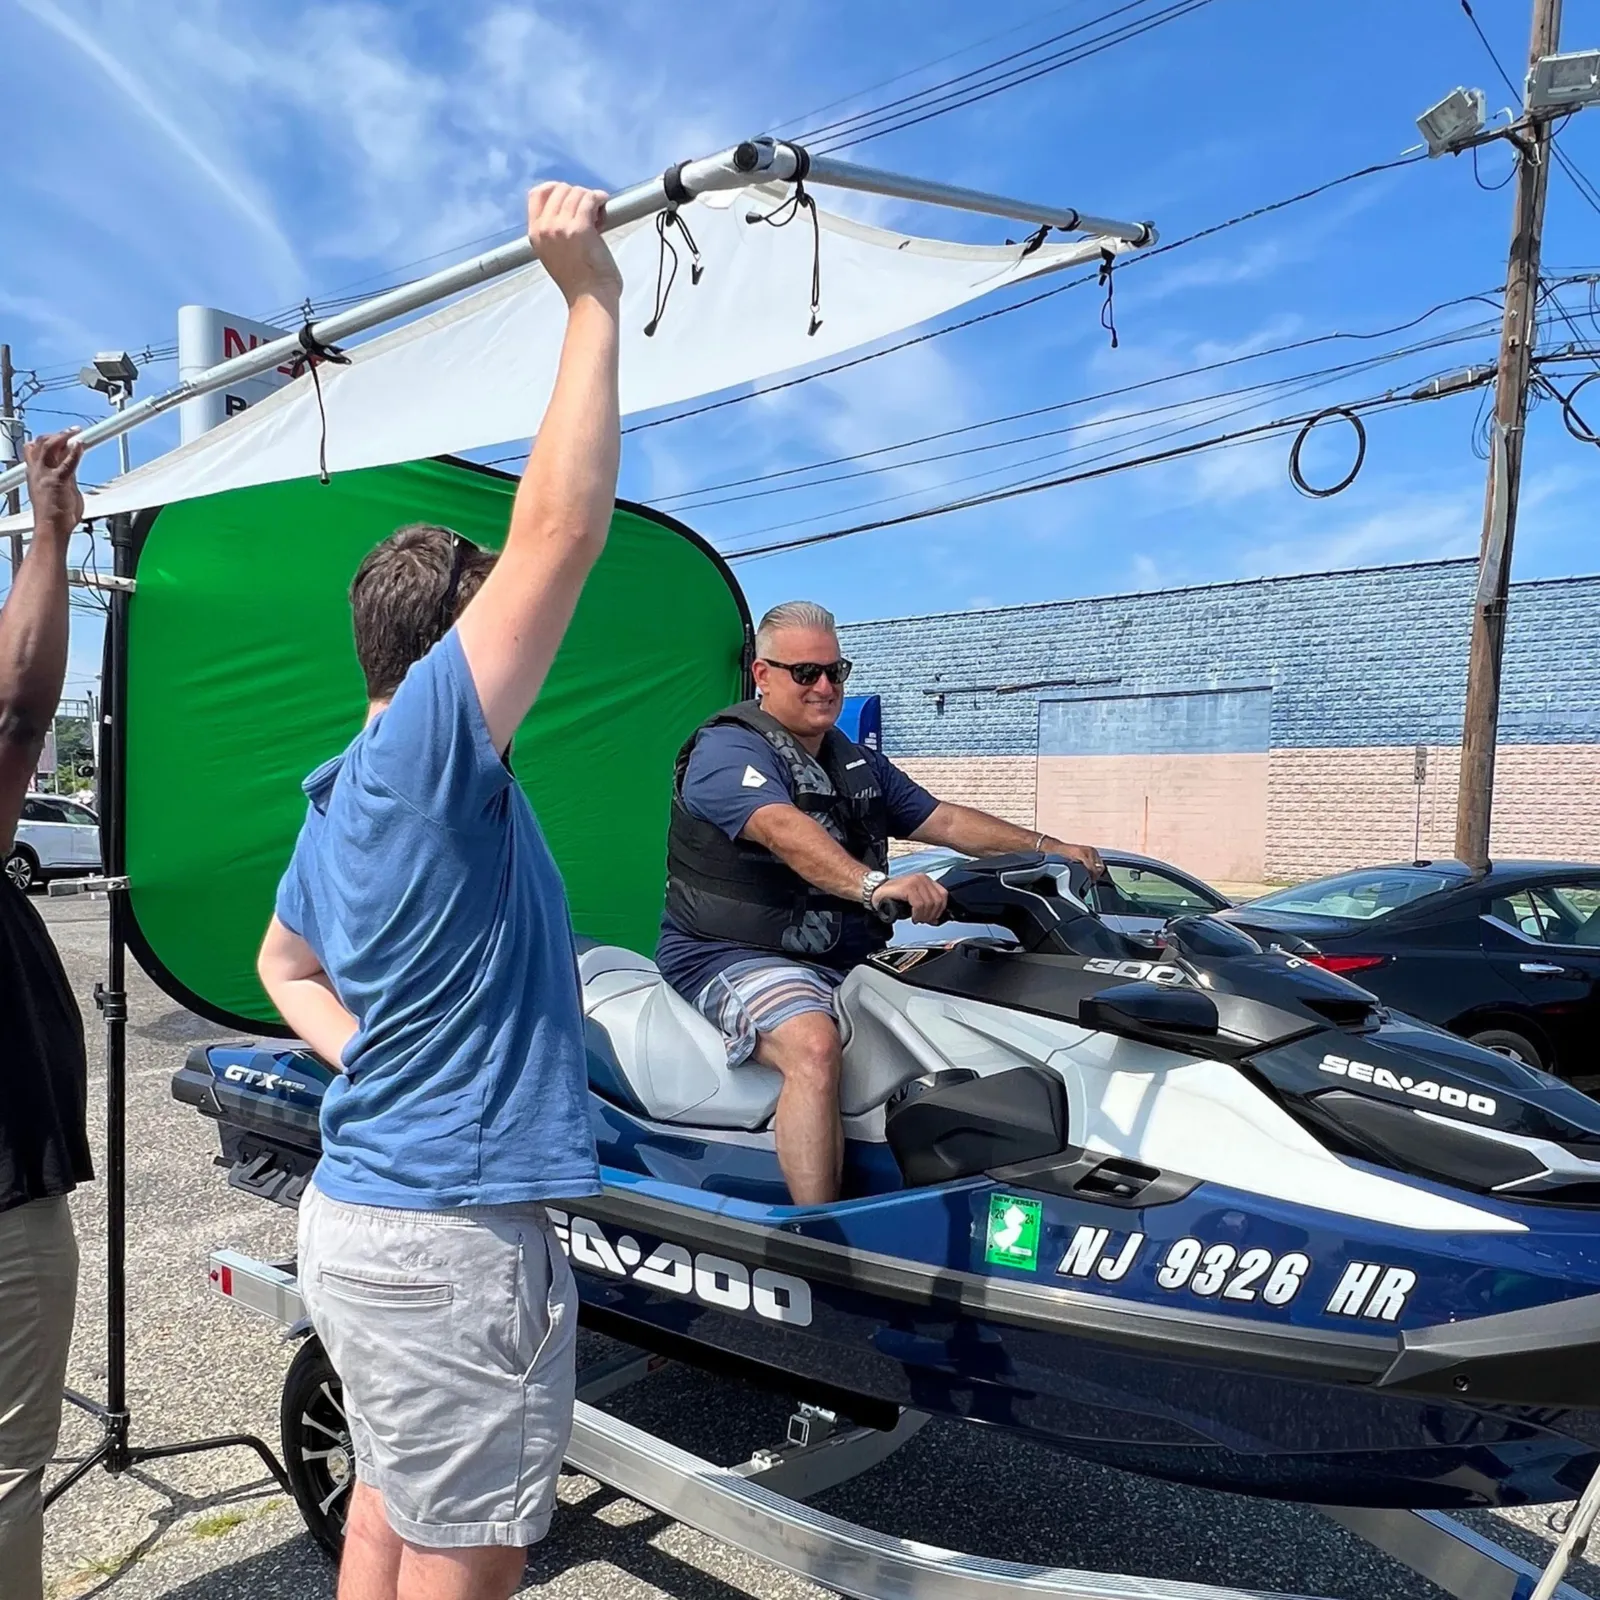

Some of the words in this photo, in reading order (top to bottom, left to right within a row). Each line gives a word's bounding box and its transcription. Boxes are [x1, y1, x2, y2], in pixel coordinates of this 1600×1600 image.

[1083, 957, 1185, 985] 300
[224, 1064, 281, 1090] GTX
[1011, 1198, 1040, 1208] JERSEY
[994, 1208, 1005, 1220] 20
[1024, 1213, 1034, 1225] 24
[1056, 1225, 1145, 1282] NJ
[1156, 1237, 1309, 1306] 9326
[1326, 1261, 1417, 1322] HR
